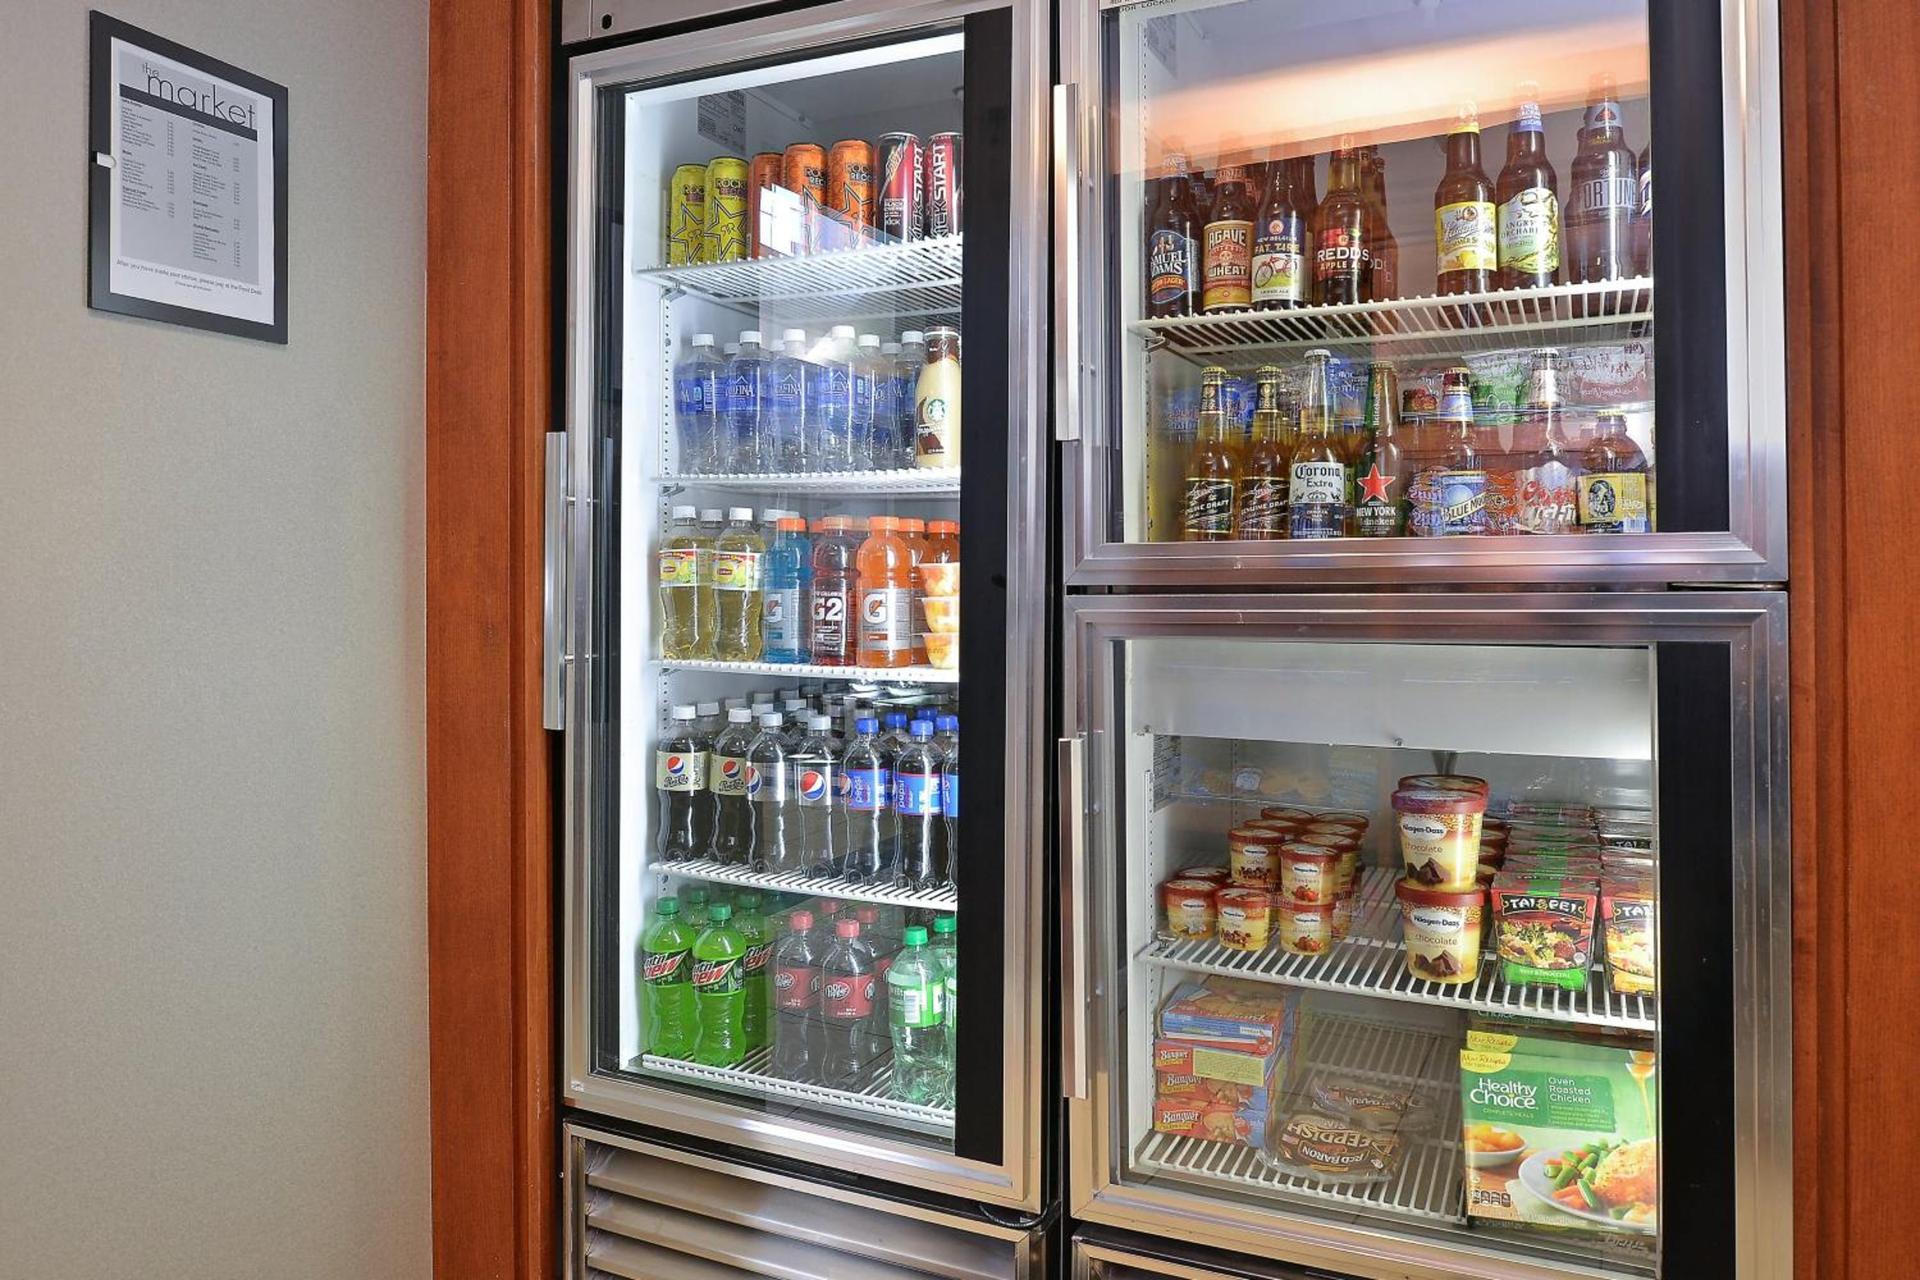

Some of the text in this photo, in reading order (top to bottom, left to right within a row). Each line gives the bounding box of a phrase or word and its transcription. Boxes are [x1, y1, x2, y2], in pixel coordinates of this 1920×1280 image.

[147, 74, 256, 130] market
[1582, 178, 1638, 210] ORTUNE
[1208, 228, 1247, 250] AGAVE
[1207, 264, 1247, 278] WHEAT
[1320, 260, 1347, 270] APPLE
[1294, 464, 1342, 480] Corona
[1306, 478, 1334, 488] Extra
[1206, 499, 1230, 510] DRAFT
[1356, 507, 1373, 517] NEW
[1373, 506, 1396, 516] YORK
[1441, 500, 1470, 520] BLUE
[814, 598, 844, 622] G2
[863, 594, 888, 624] G
[1509, 898, 1577, 911] TAI PEI
[1479, 1077, 1538, 1098] Healthy
[1548, 1077, 1576, 1087] Oven
[1549, 1085, 1592, 1097] Roasted
[1470, 1088, 1537, 1110] Choice
[1549, 1093, 1592, 1105] Chicken
[1162, 1110, 1199, 1124] Banquet
[1301, 1145, 1347, 1164] BARON
